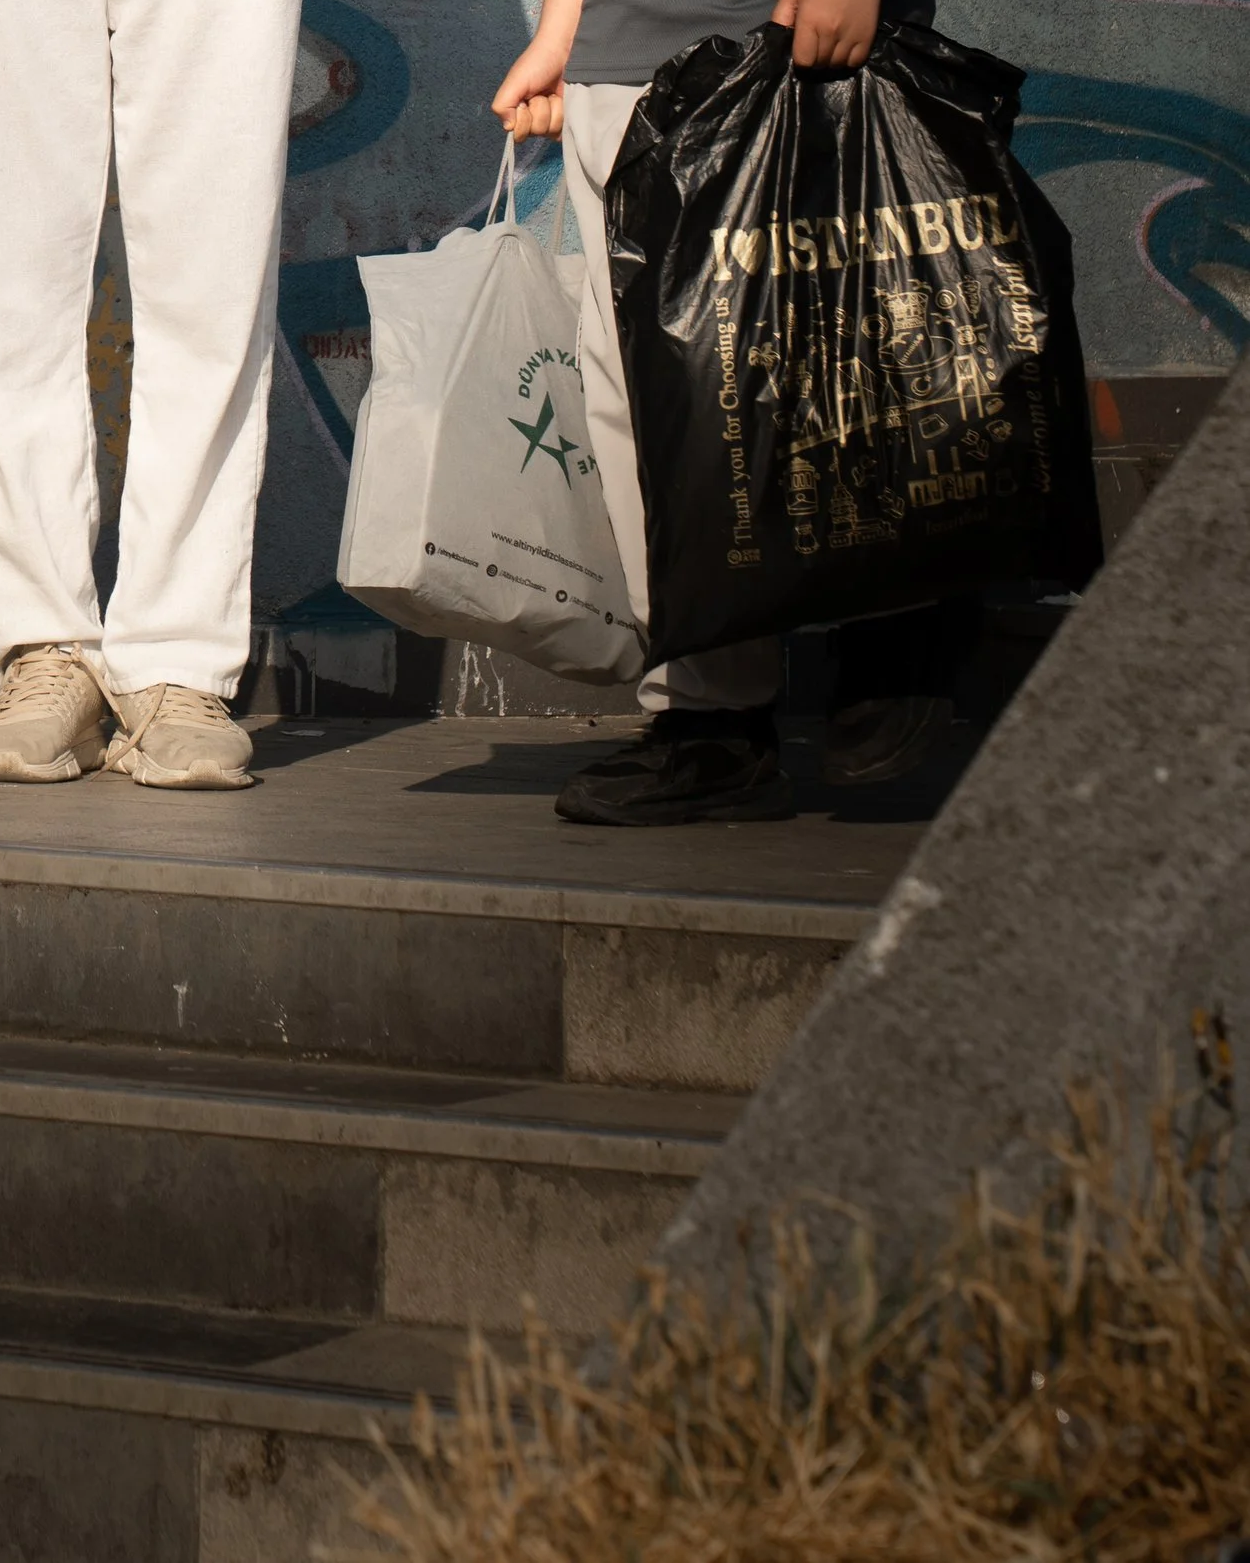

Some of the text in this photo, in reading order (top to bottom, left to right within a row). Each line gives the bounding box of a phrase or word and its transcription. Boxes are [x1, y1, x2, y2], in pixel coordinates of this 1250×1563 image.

[767, 192, 1018, 277] İSTANBUL
[713, 296, 730, 318] us
[518, 347, 554, 399] DÜNYA
[714, 322, 741, 410] Choosing
[1016, 361, 1041, 384] to
[721, 414, 743, 442] for
[1023, 390, 1053, 495] Welcome
[728, 447, 751, 481] you
[727, 486, 753, 545] Thank
[491, 530, 604, 584] www.altinyildizclassics.com.tr
